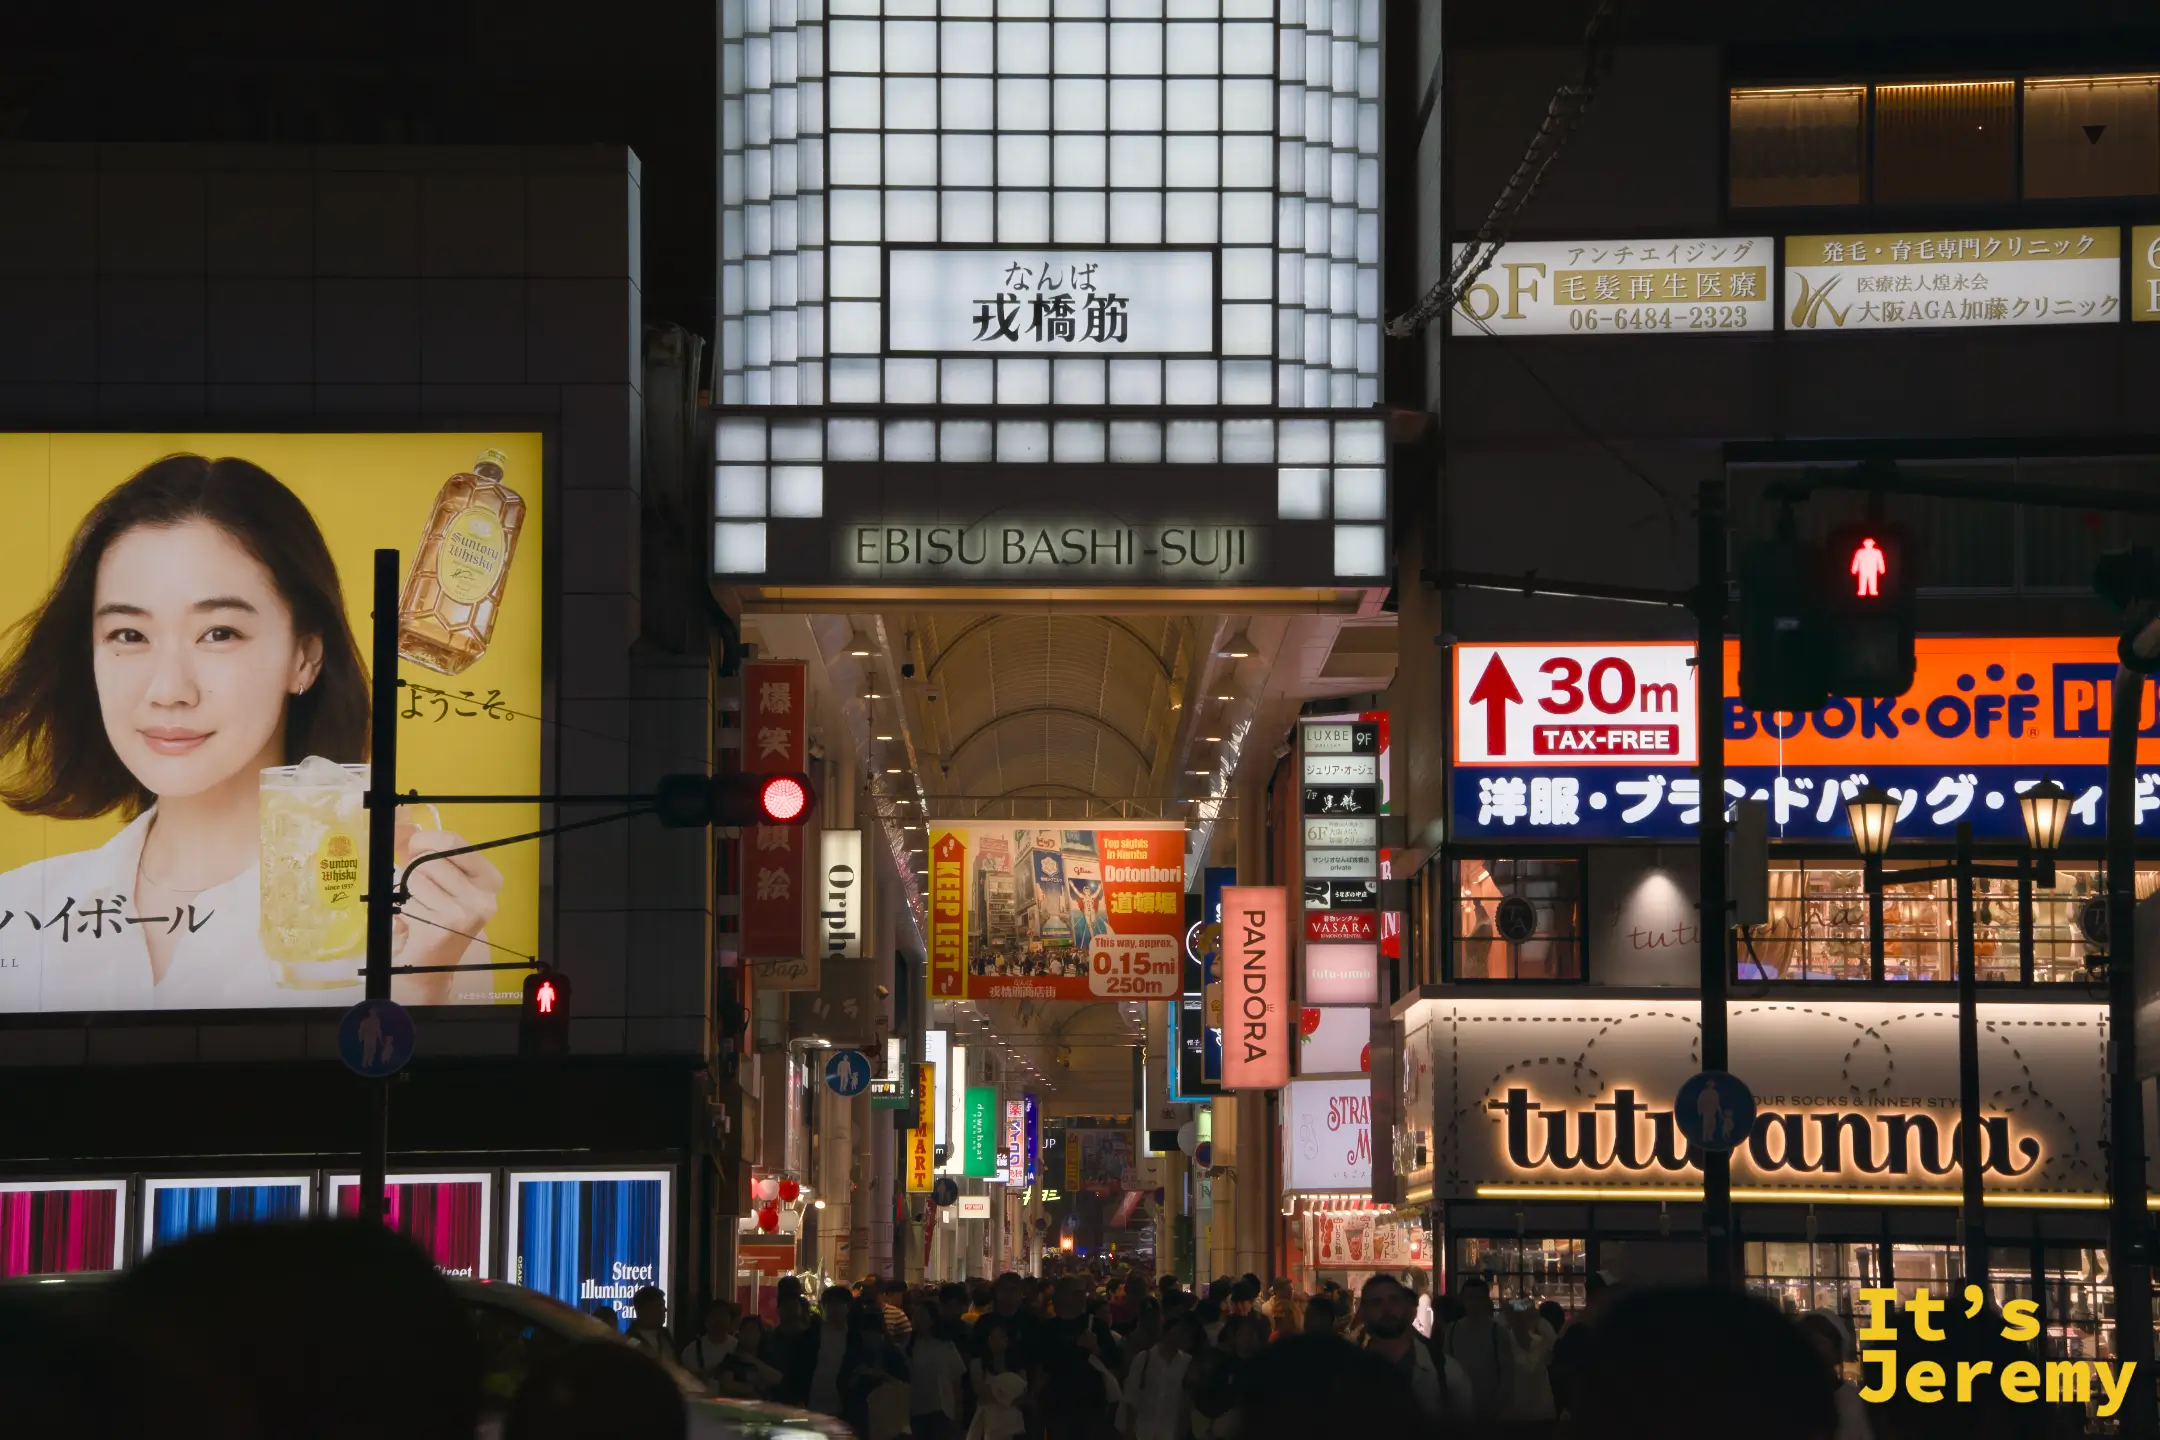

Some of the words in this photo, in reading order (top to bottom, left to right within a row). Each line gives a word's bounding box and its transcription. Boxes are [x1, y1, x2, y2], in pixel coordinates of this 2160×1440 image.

[1567, 240, 1754, 267] アンチエイジング
[1822, 233, 2096, 263] 発毛・育毛専門クリニック
[1003, 262, 1099, 293] なんば
[1559, 271, 1758, 301] 毛髪再生医療
[1856, 273, 1990, 294] 医療法人煌永会
[971, 292, 1130, 345] 戎橋筋
[1569, 305, 1748, 331] 06-6484-2323
[1856, 295, 2120, 324] 大阪AGA加藤クリニック
[855, 527, 989, 567] EBISU
[1538, 656, 1680, 716] 30m
[400, 688, 515, 723] ようこそ。
[1306, 730, 1349, 742] LUXBE
[1356, 733, 1372, 746] 9F
[1542, 729, 1671, 751] TAX-FREE
[1306, 764, 1374, 776] ジュリア・オージェ
[756, 682, 793, 900] 爆笑顔絵
[1306, 789, 1318, 800] 7F
[1308, 826, 1328, 841] 6F
[320, 859, 358, 869] Suntory
[322, 870, 357, 882] Whisky
[1105, 866, 1182, 883] Dotonbori
[936, 861, 960, 916] KEEP
[821, 864, 856, 959] Orph
[1111, 892, 1177, 914] 道頓堀
[0, 895, 216, 943] ハイボール
[1312, 923, 1371, 933] VASARA
[935, 922, 959, 972] LEFT
[1095, 938, 1115, 947] This
[1139, 939, 1174, 949] approx.
[1093, 952, 1176, 975] 0.15mi
[1106, 977, 1162, 994] 250m
[1327, 1096, 1371, 1131] STRA
[1792, 1096, 1848, 1107] SOCKS
[1853, 1096, 1865, 1107] &
[1869, 1096, 1922, 1107] INNER
[1927, 1097, 1960, 1108] STY
[612, 1261, 653, 1281] Street
